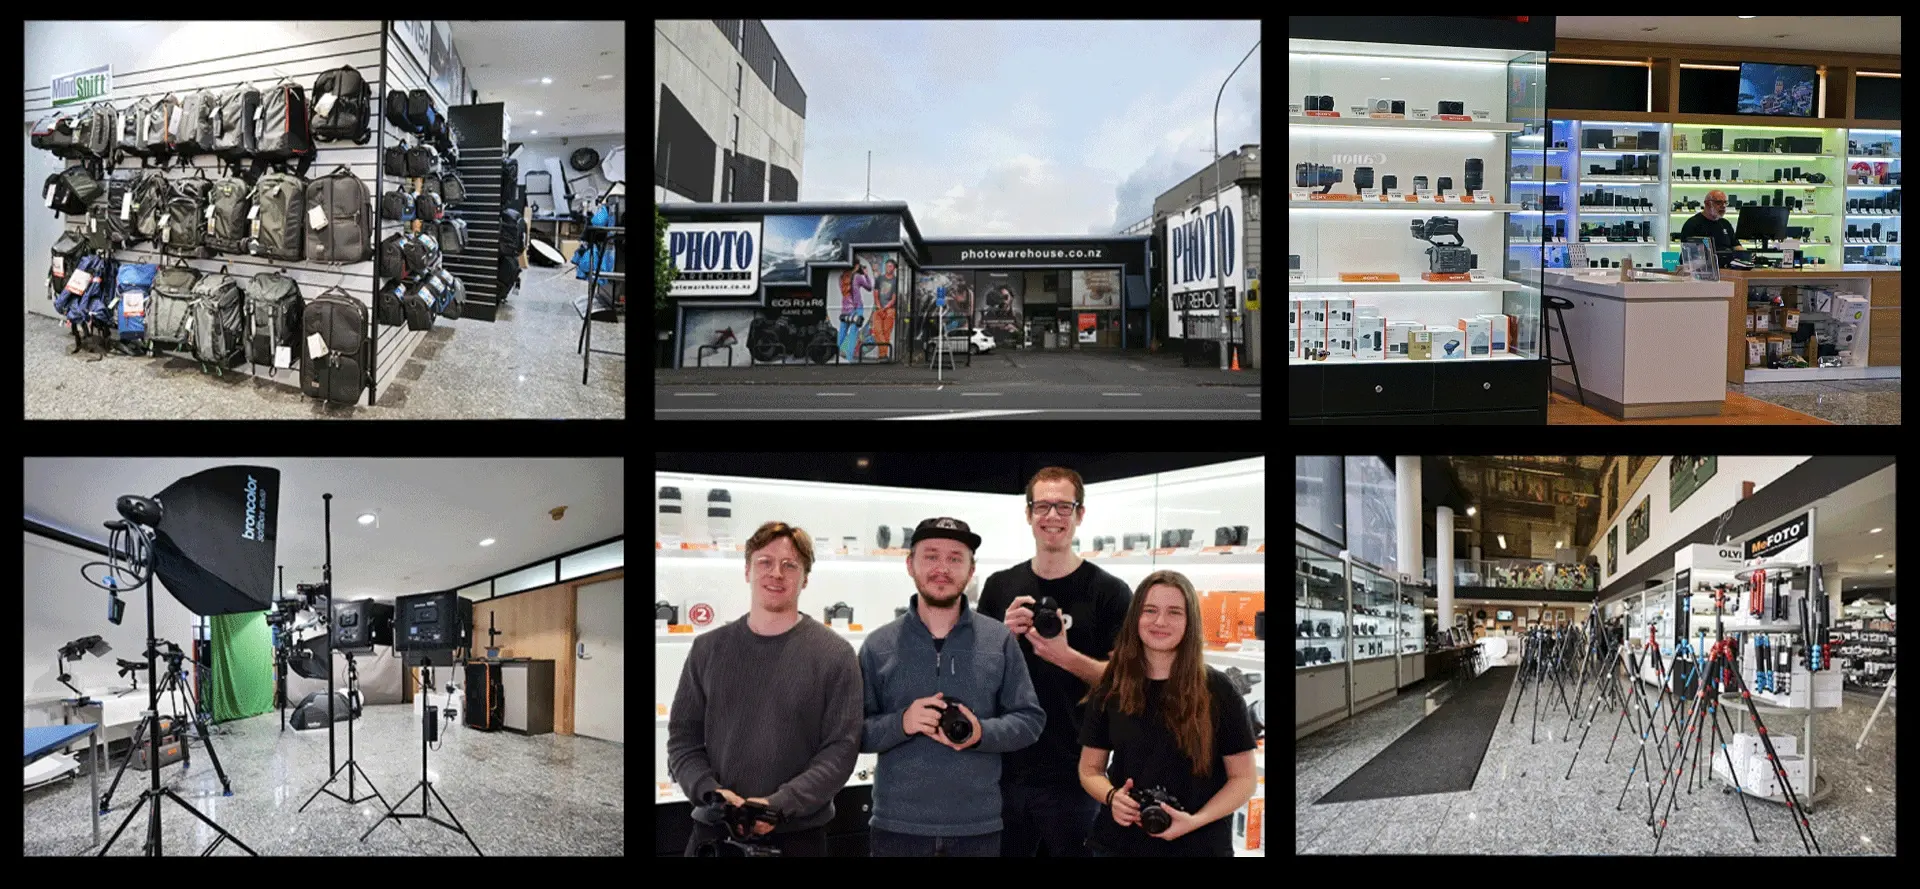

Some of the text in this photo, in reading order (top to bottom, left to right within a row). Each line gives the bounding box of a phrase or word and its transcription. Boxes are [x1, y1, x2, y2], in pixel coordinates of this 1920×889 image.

[52, 74, 106, 98] MindShift
[668, 231, 754, 271] PHOTO
[961, 249, 1102, 261] photowarehouse.co.nz
[1172, 205, 1235, 285] PHOTO
[677, 272, 752, 280] AREHOUSE
[241, 474, 257, 540] broncolor
[697, 608, 708, 621] 2
